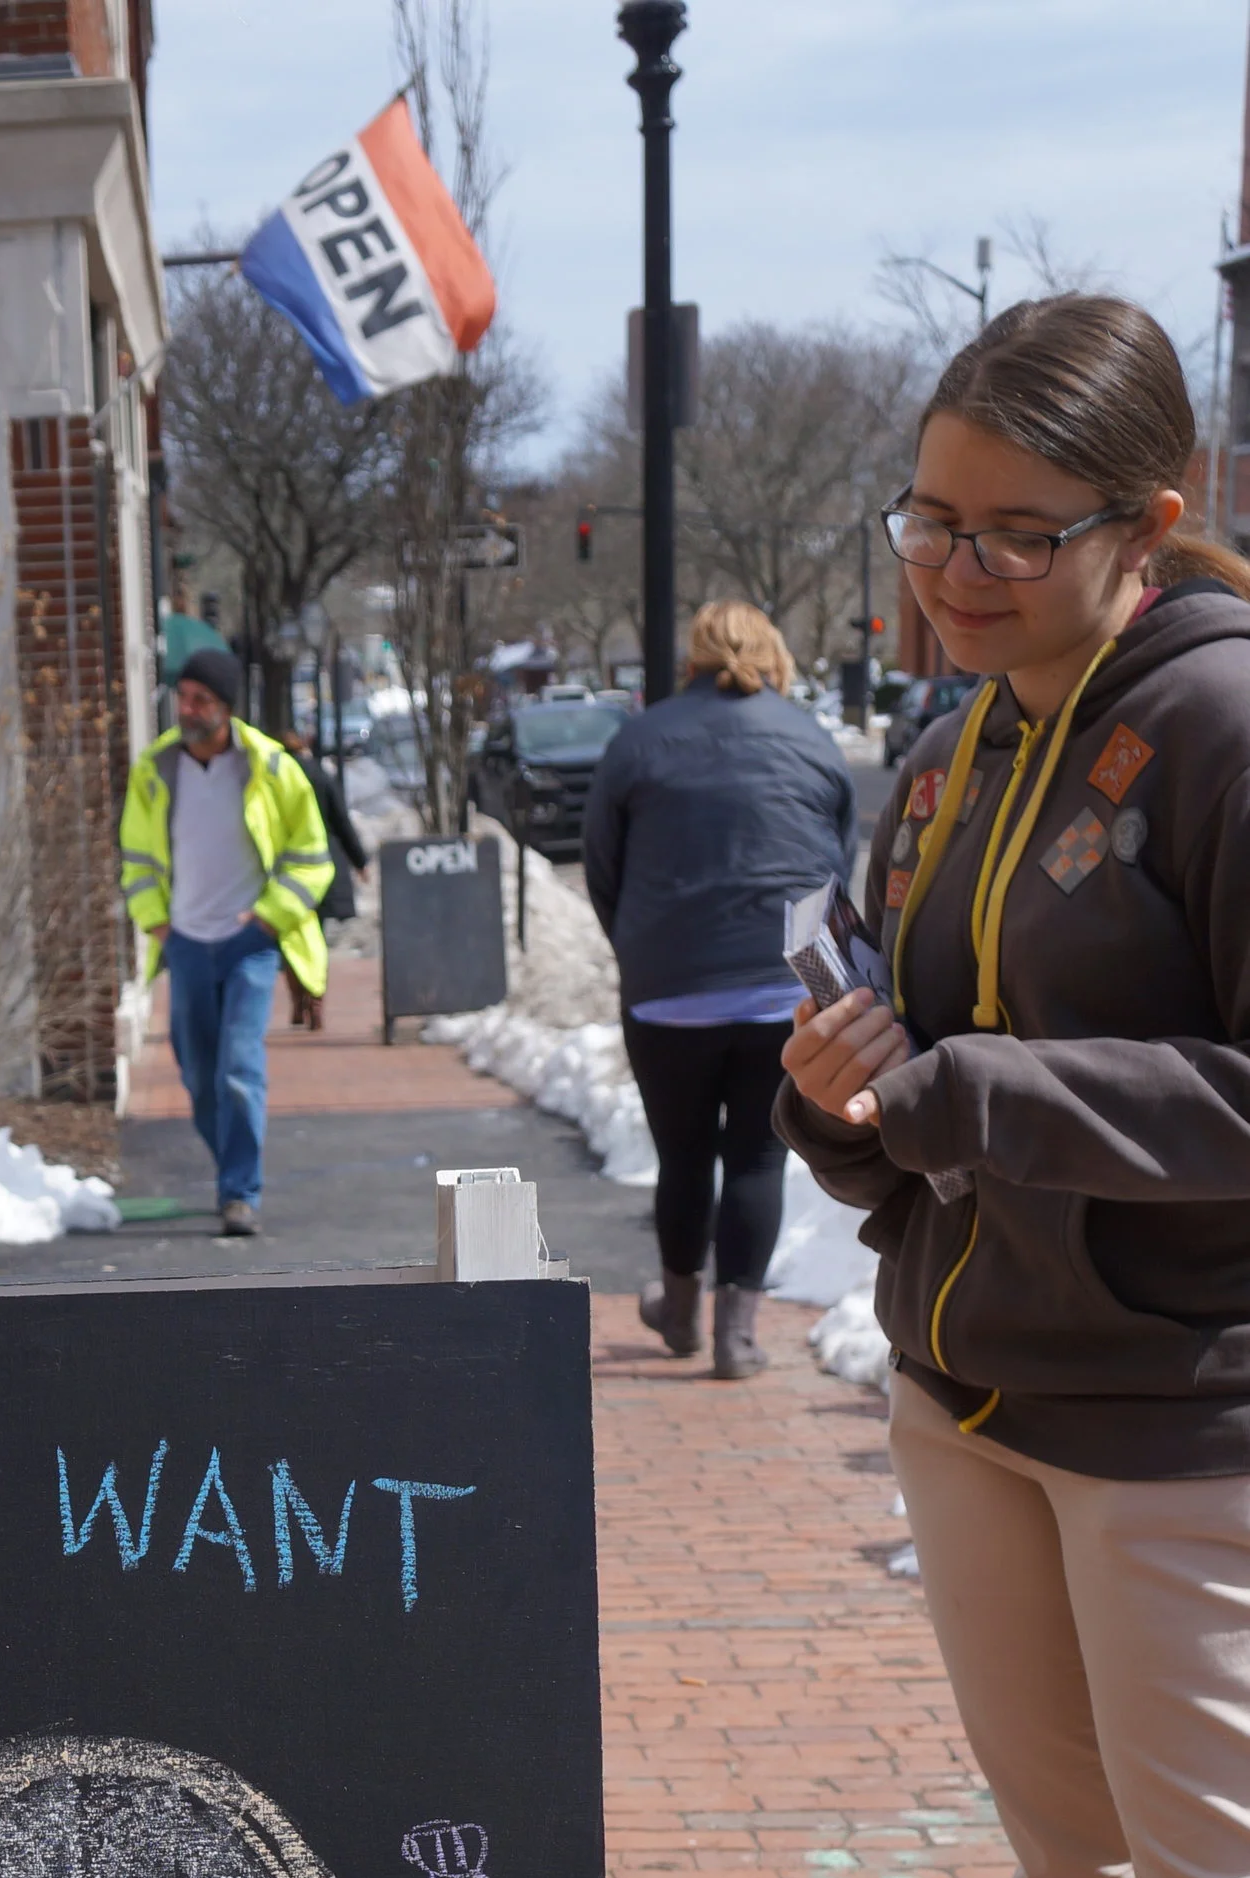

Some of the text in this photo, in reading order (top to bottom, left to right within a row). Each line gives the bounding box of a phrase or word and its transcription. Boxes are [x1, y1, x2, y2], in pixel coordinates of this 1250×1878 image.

[294, 149, 426, 335] OPEN
[406, 842, 478, 875] OPEN
[57, 1438, 476, 1611] WANT
